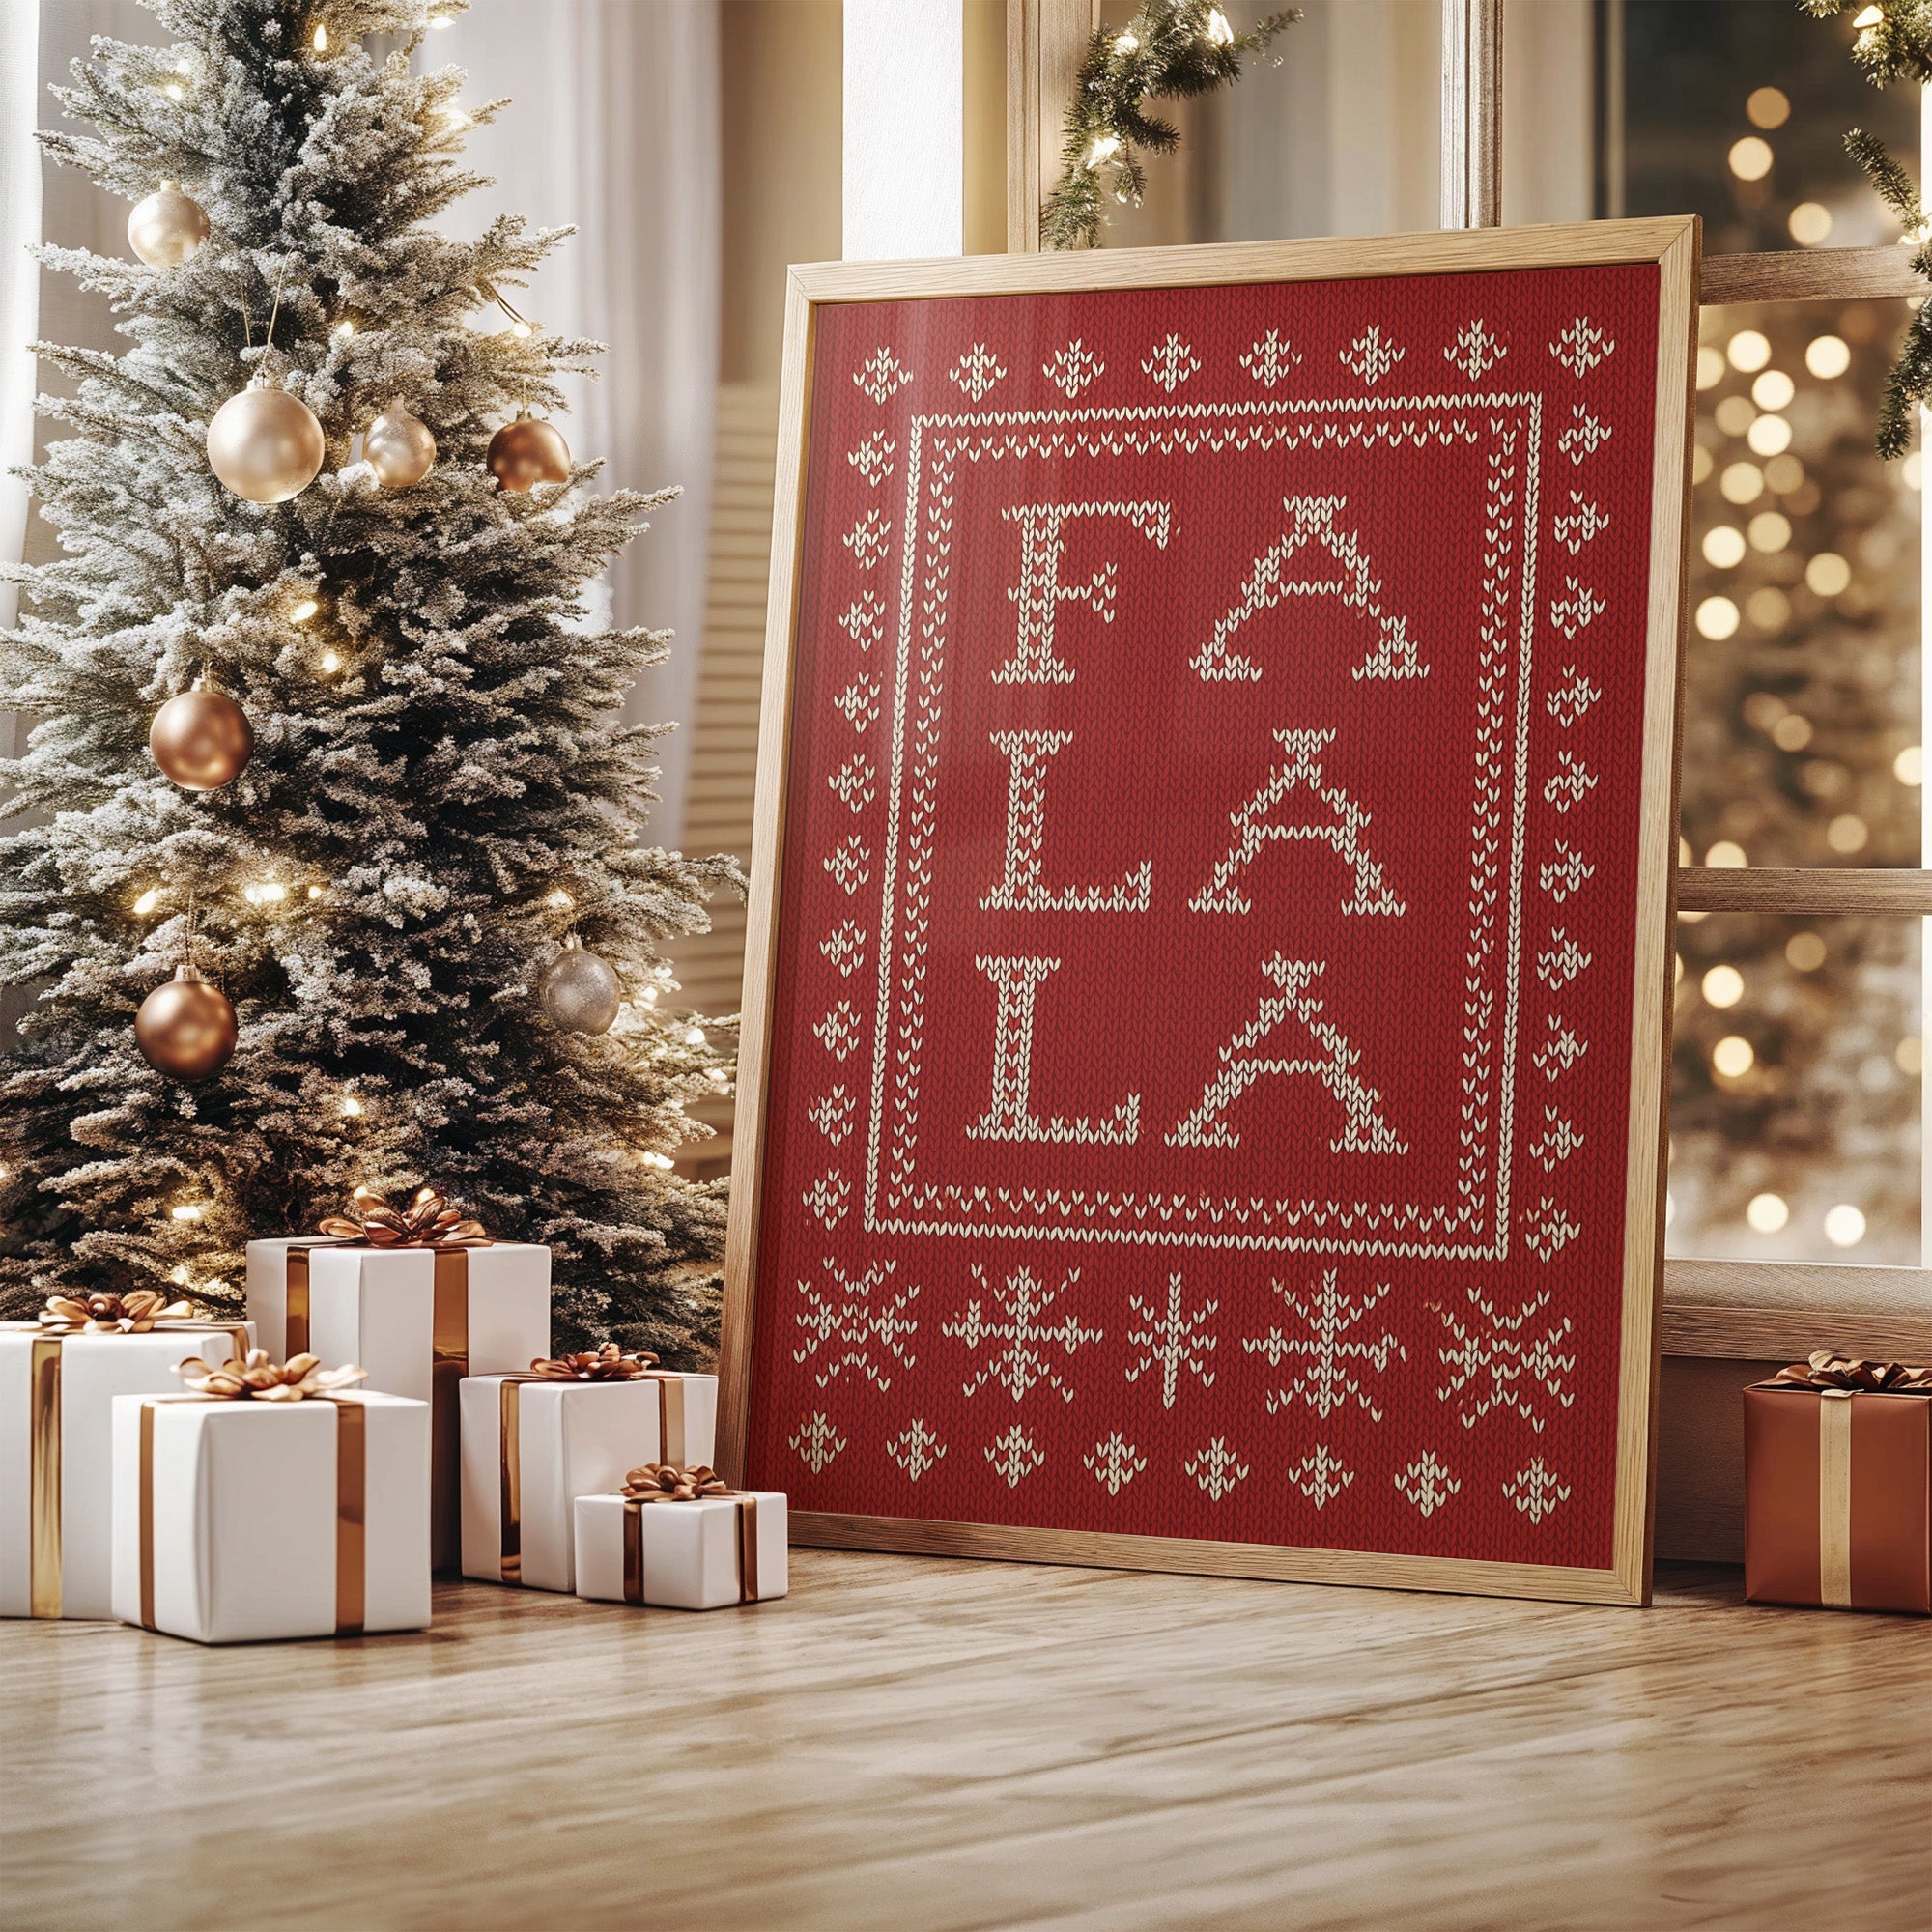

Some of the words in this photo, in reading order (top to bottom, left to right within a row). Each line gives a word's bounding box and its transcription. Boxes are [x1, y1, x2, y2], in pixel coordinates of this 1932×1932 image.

[991, 495, 1430, 684] FA
[979, 728, 1406, 917] LA
[966, 952, 1408, 1154] LA
